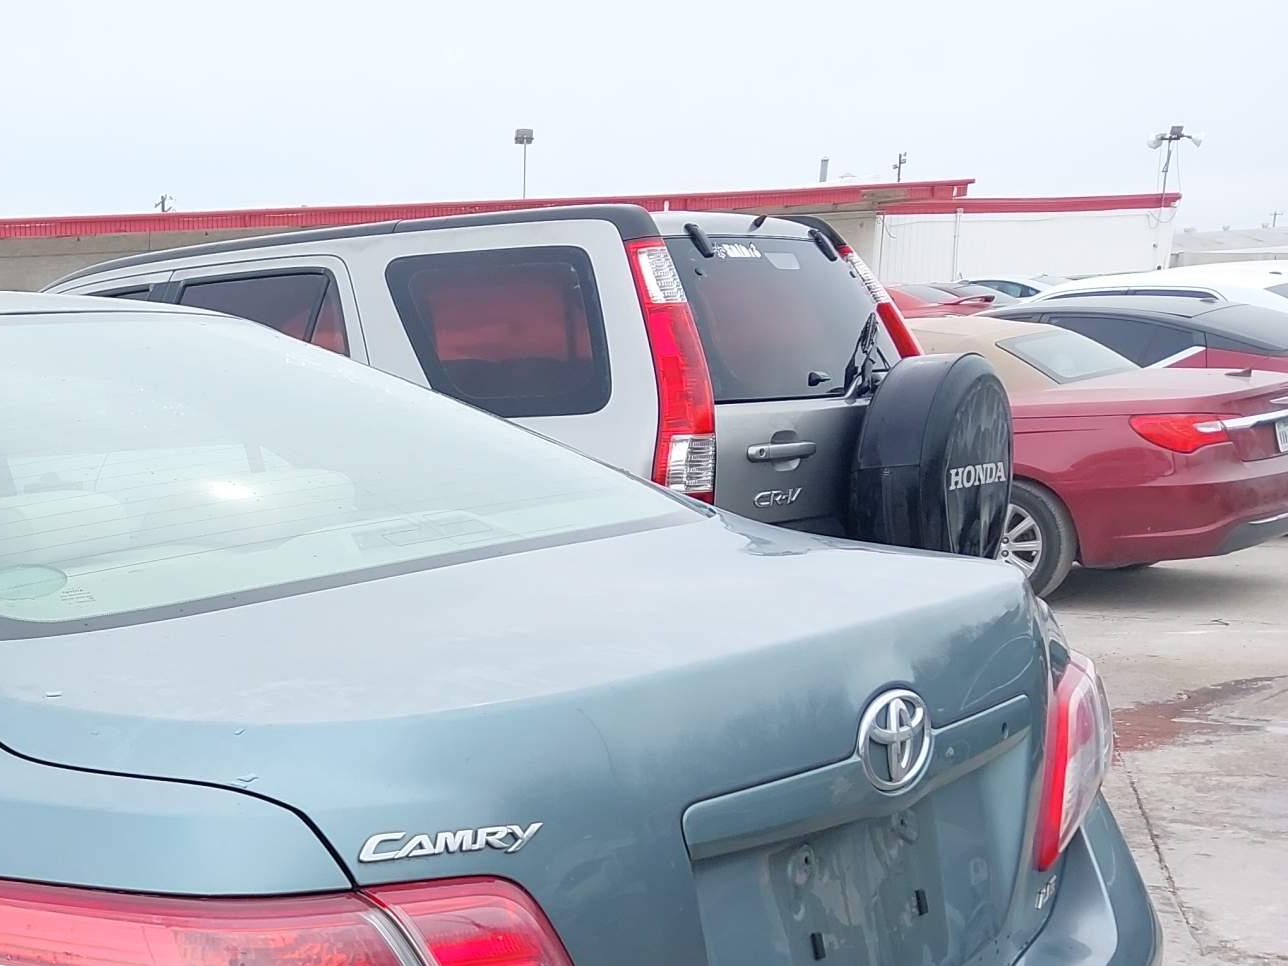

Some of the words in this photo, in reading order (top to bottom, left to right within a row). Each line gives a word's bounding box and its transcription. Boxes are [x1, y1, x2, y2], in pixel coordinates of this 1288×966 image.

[949, 461, 1007, 491] HONDA
[754, 487, 802, 508] CR-V
[358, 821, 544, 863] CAMRY
